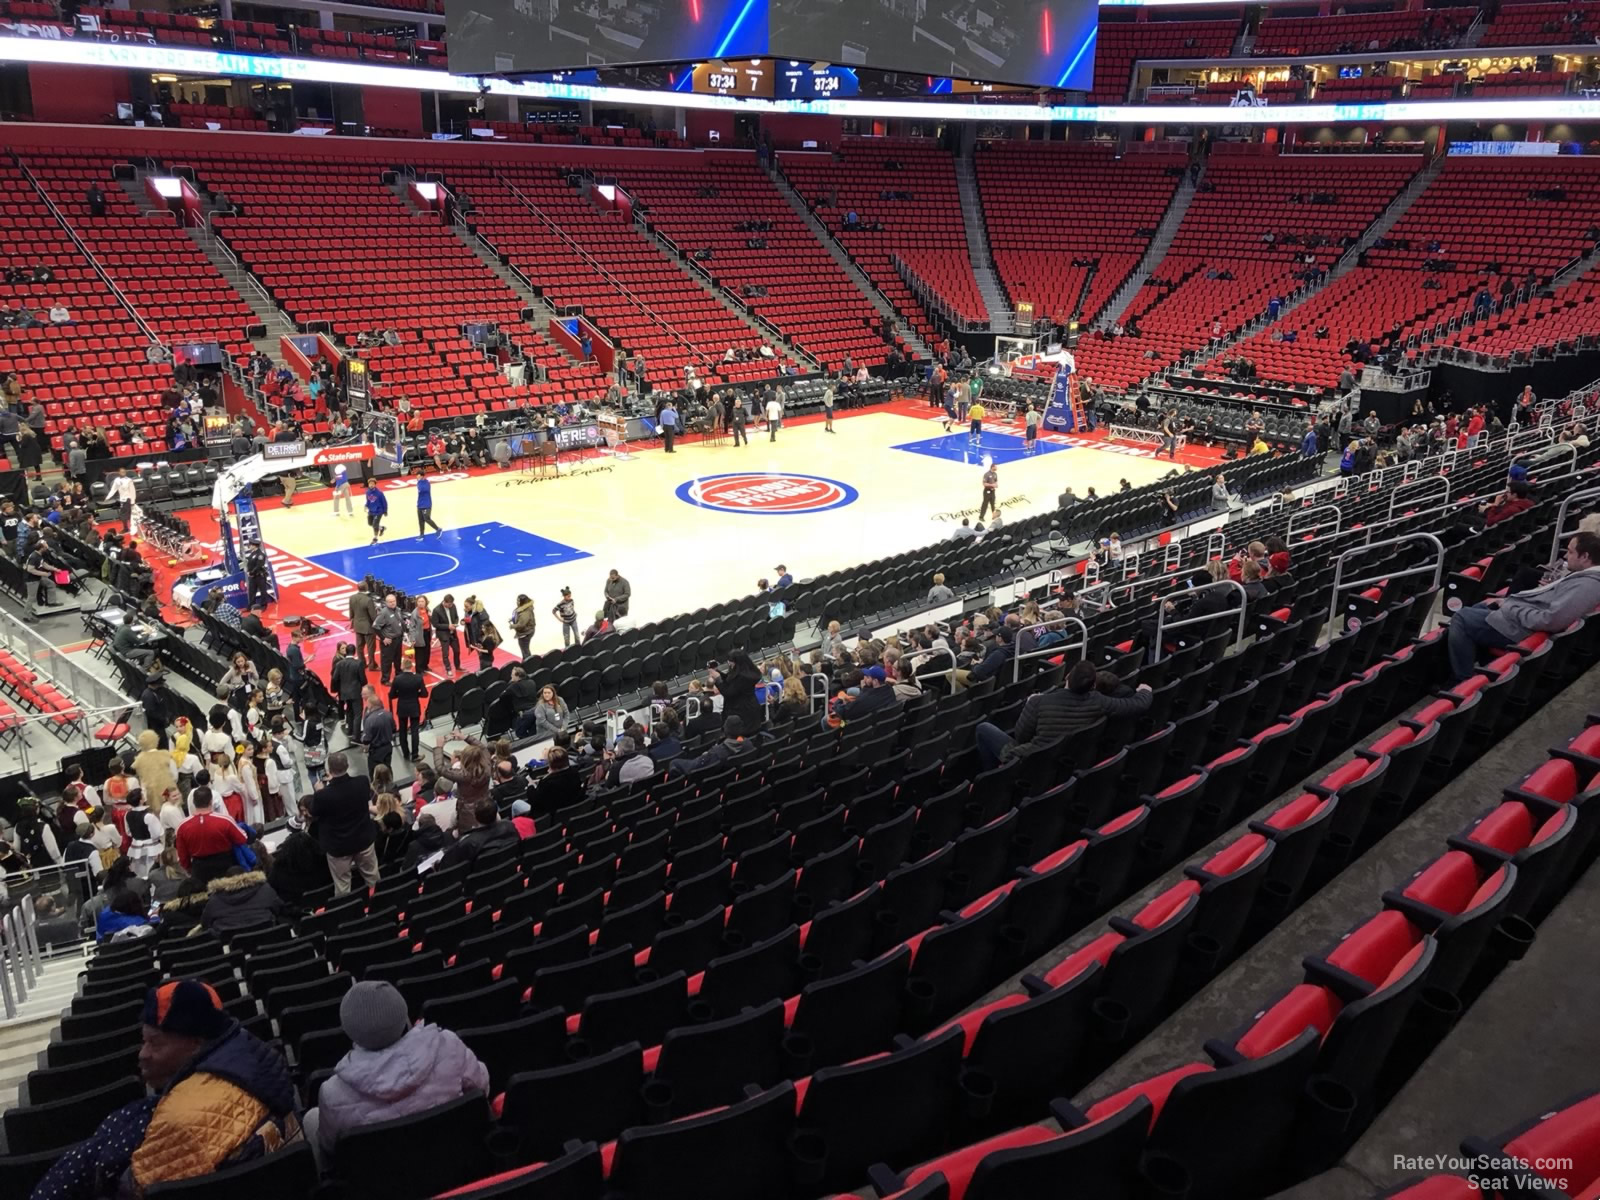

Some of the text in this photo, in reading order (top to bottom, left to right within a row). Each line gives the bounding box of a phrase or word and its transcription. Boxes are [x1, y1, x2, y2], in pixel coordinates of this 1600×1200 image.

[192, 53, 250, 74] HEALTH
[252, 57, 309, 77] SYSTEM
[710, 74, 735, 89] 37:34
[751, 77, 758, 91] 7
[790, 78, 798, 93] 7
[815, 76, 839, 91] 37:34
[267, 444, 302, 454] DETROIT
[711, 479, 797, 500] DETROIT
[729, 484, 823, 506] PISTONS
